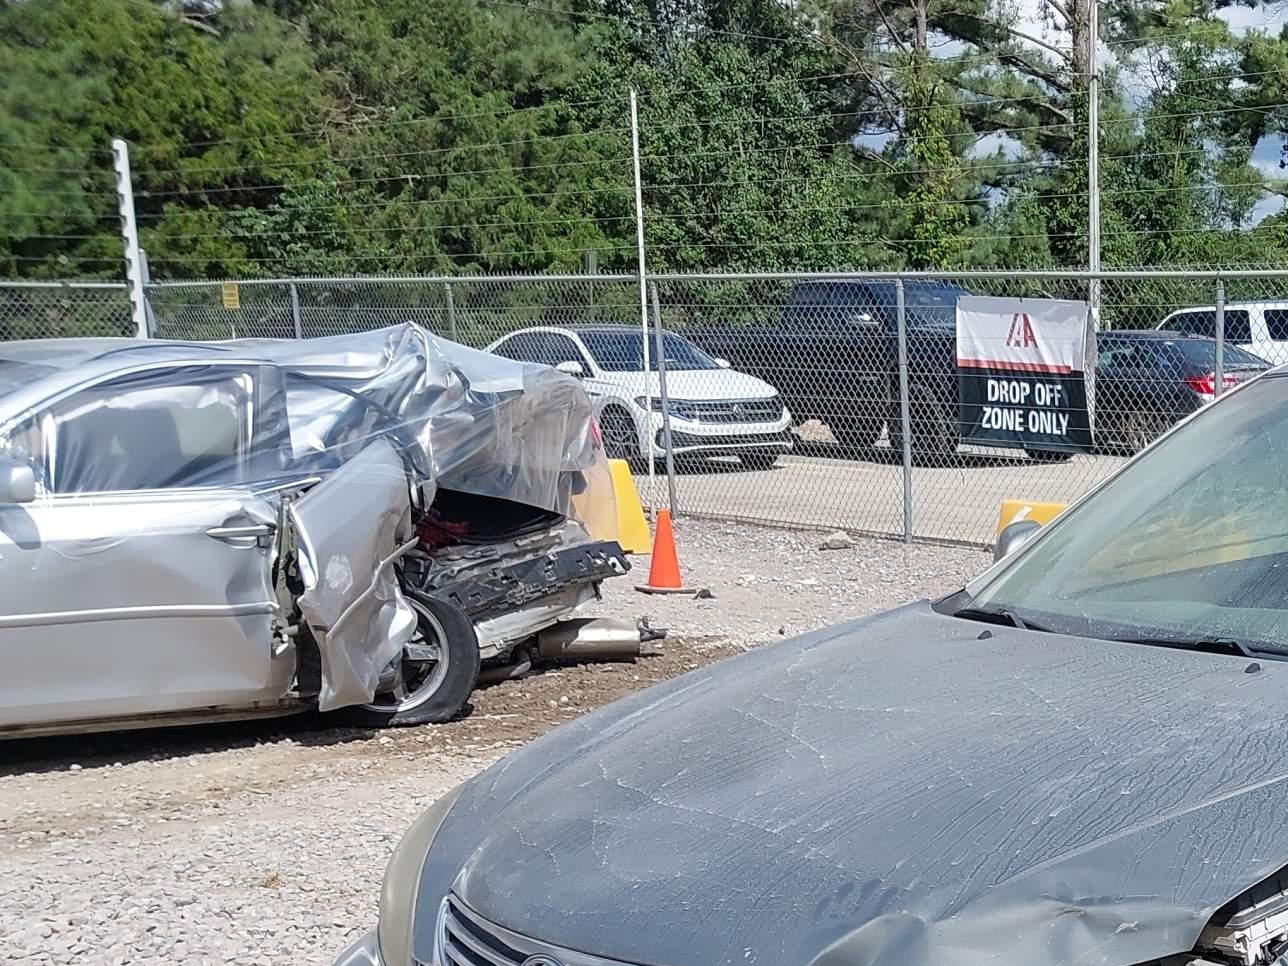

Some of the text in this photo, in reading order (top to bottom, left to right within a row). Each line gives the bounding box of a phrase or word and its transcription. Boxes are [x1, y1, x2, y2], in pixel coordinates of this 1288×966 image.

[987, 379, 1062, 407] DROP OFF
[981, 406, 1069, 436] ZONE ONLY
